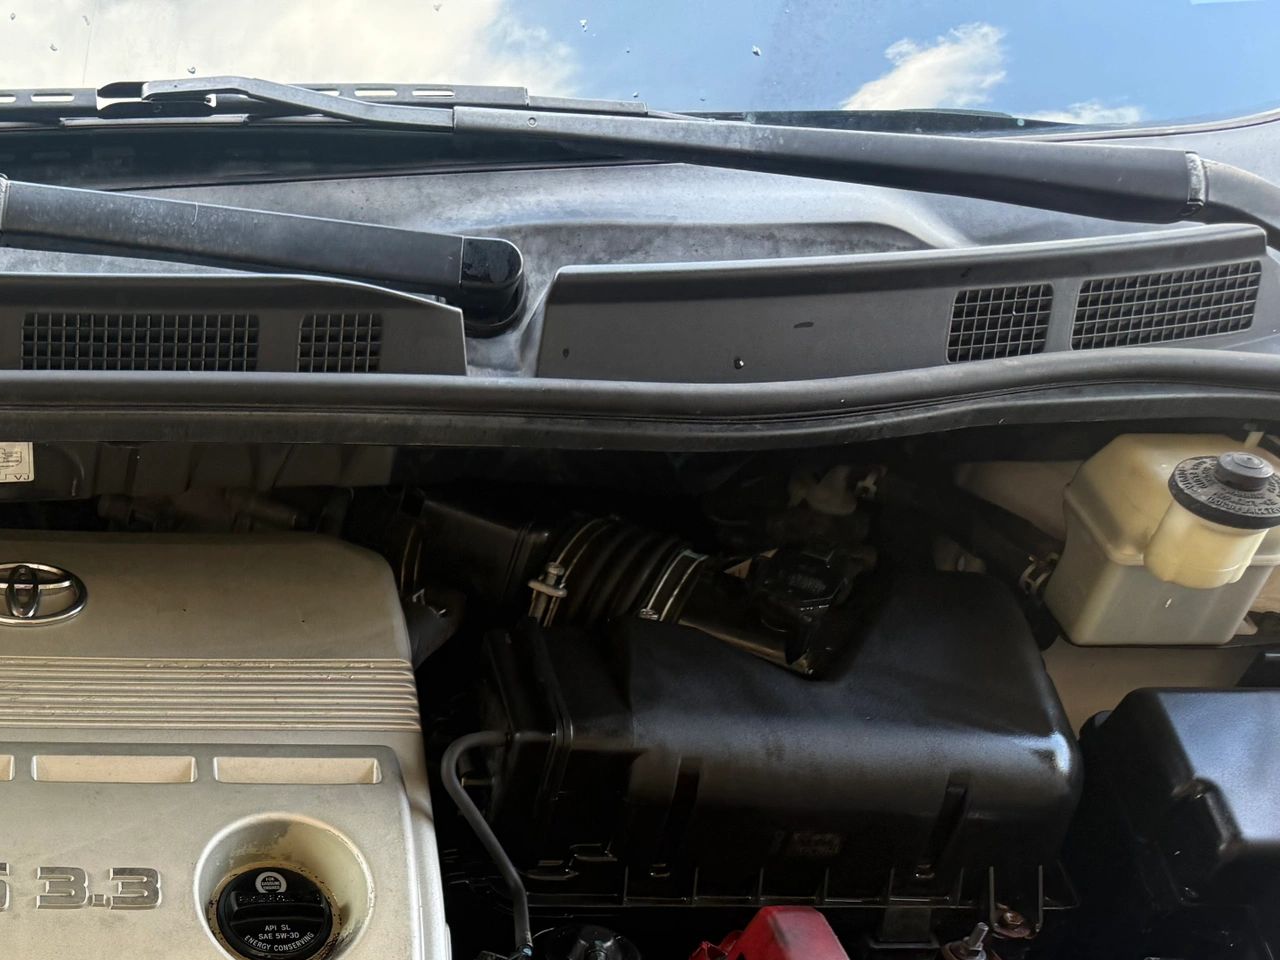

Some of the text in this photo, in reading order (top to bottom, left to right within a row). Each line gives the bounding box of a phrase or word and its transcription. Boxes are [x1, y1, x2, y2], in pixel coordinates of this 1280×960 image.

[36, 864, 164, 912] 3.3
[244, 931, 314, 952] ENERGY CONSERVING
[276, 931, 300, 939] 5W-30
